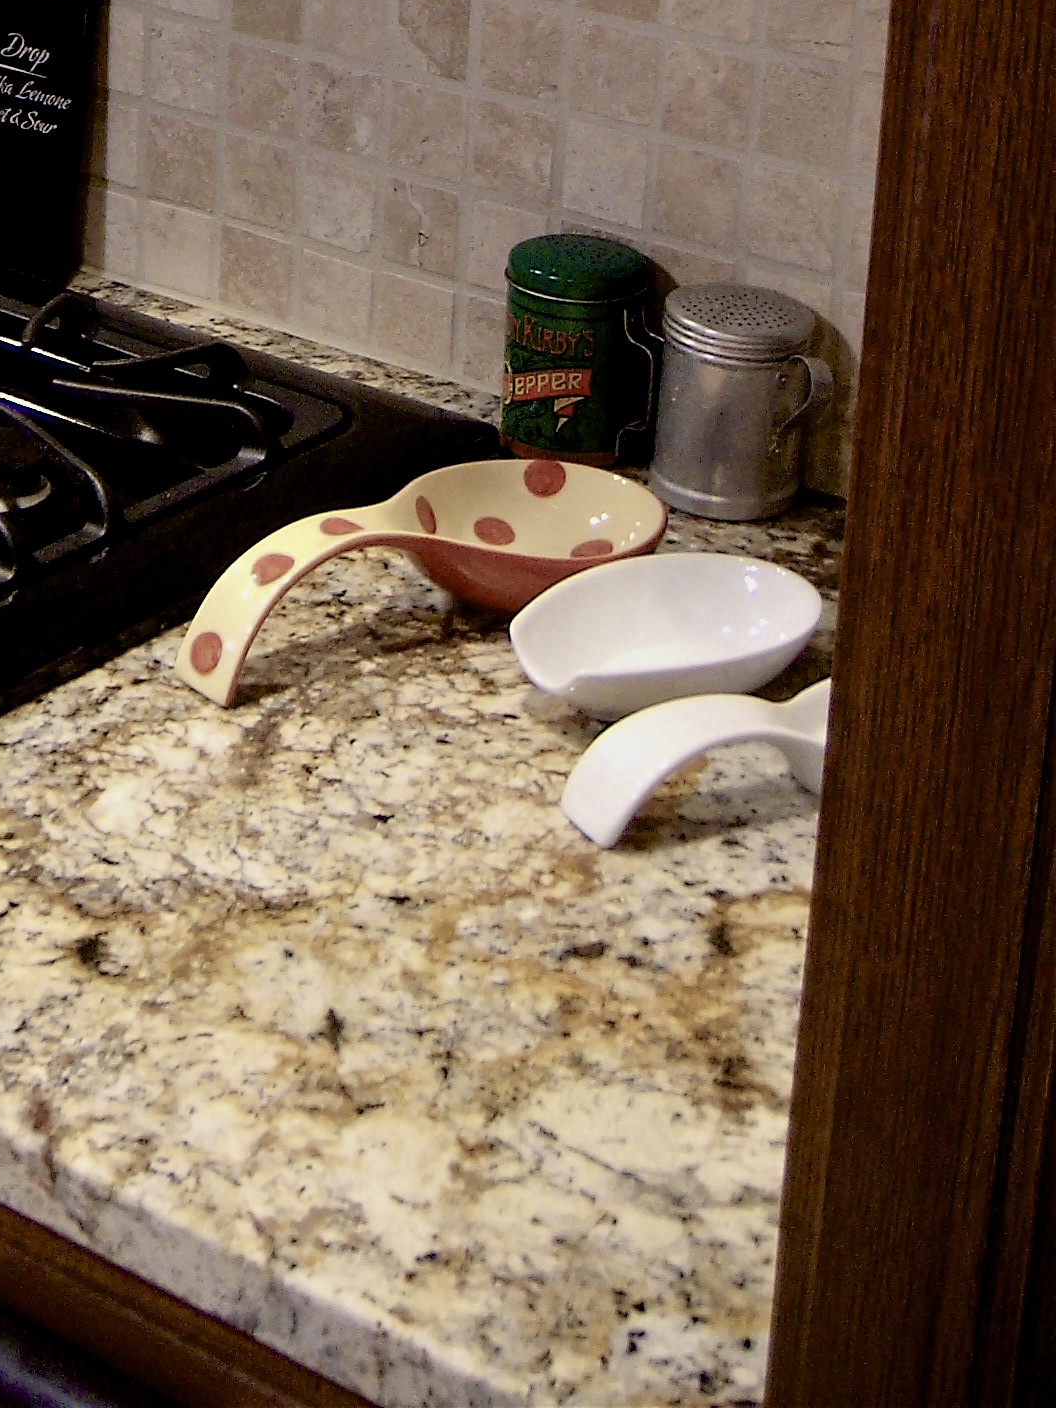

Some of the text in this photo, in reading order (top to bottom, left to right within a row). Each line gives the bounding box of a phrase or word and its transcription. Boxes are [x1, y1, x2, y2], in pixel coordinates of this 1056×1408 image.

[0, 32, 51, 73] Drop
[9, 108, 23, 127] &
[20, 110, 58, 134] Sour
[509, 372, 583, 395] EPPER
